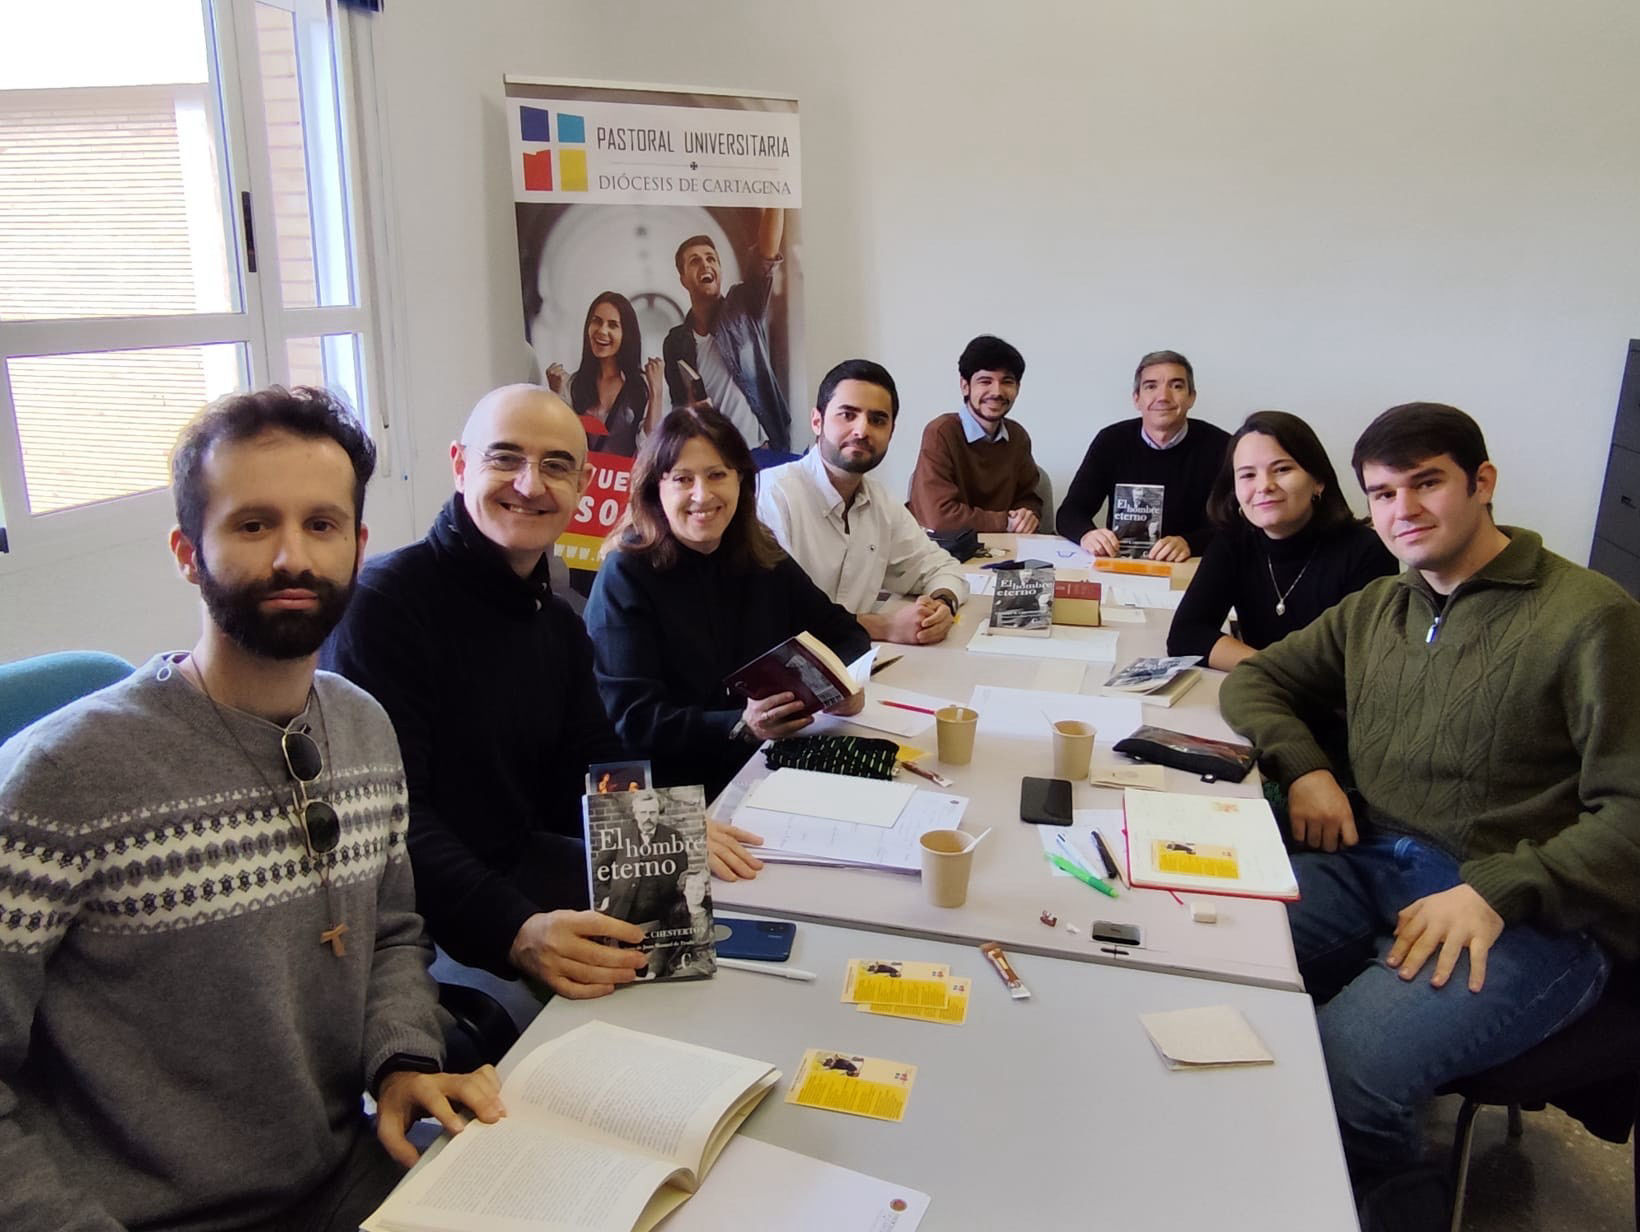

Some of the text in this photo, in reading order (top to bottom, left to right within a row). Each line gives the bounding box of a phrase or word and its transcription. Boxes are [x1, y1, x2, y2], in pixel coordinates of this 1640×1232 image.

[597, 127, 790, 158] PASTORAL UNIVERSITARIA
[599, 173, 792, 195] DIÓCESIS DE CARTAGENA
[593, 467, 631, 492] UE
[1117, 499, 1128, 509] El
[1114, 512, 1148, 522] eterno
[996, 588, 1037, 597] eterno
[1000, 579, 1013, 588] El
[1012, 580, 1053, 590] hombre
[600, 828, 624, 851] El
[625, 834, 706, 858] hombre
[597, 858, 677, 882] eterno
